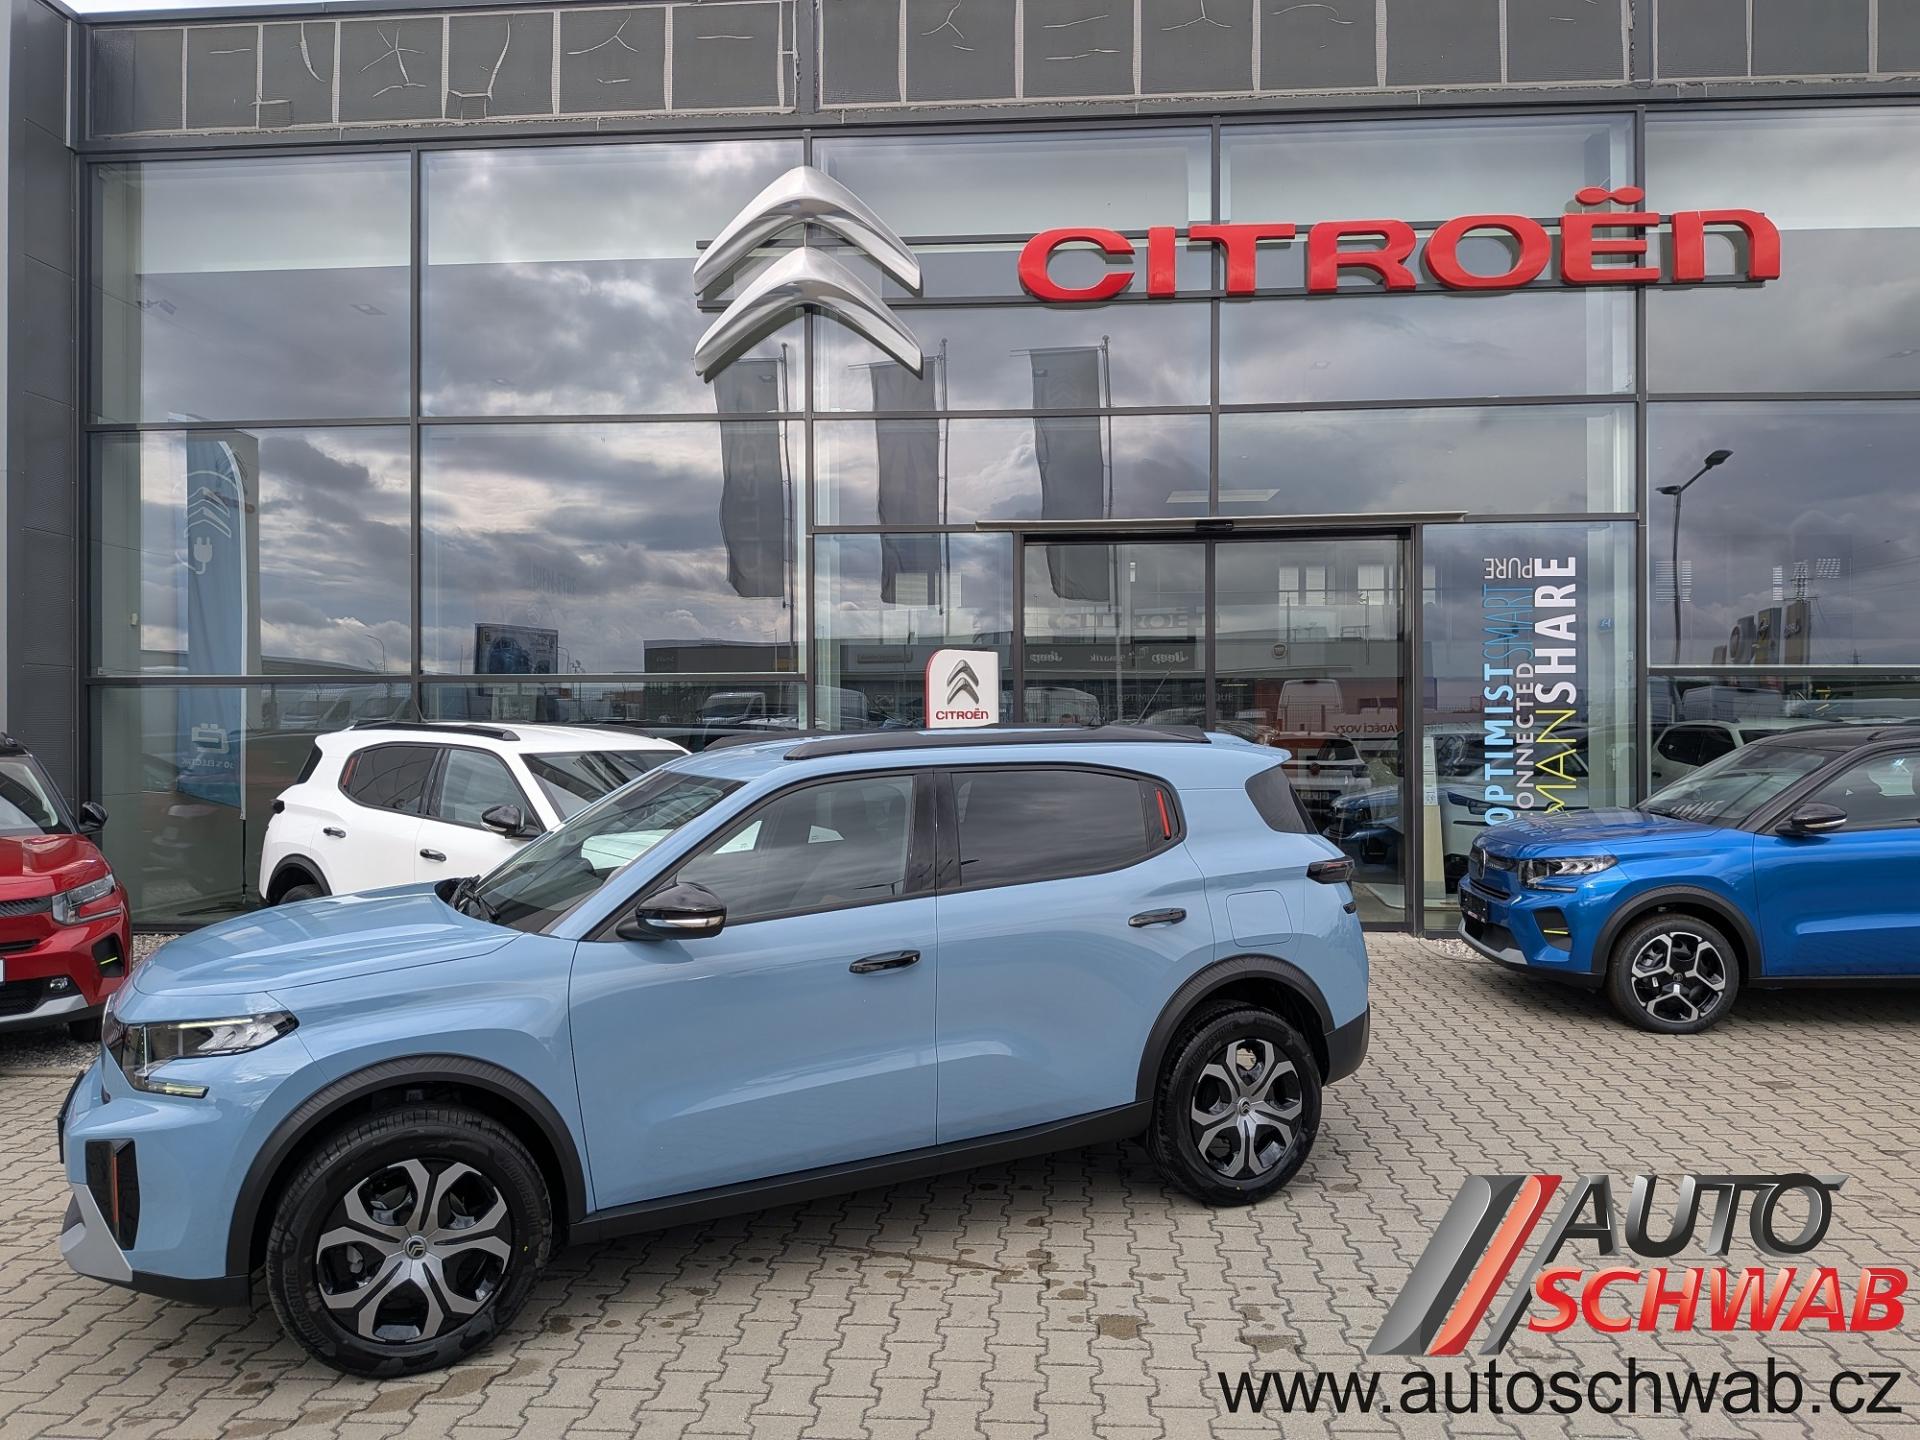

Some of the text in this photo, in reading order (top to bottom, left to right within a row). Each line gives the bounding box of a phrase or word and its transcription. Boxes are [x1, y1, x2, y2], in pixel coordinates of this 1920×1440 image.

[1017, 186, 1781, 301] CITROËN
[1483, 557, 1534, 579] PURE
[1483, 583, 1534, 660] SMART
[1535, 556, 1577, 704] SHARE
[935, 707, 989, 720] CITROËN
[1483, 663, 1515, 827] OPTIMIST
[1515, 662, 1535, 818] ONNECTED
